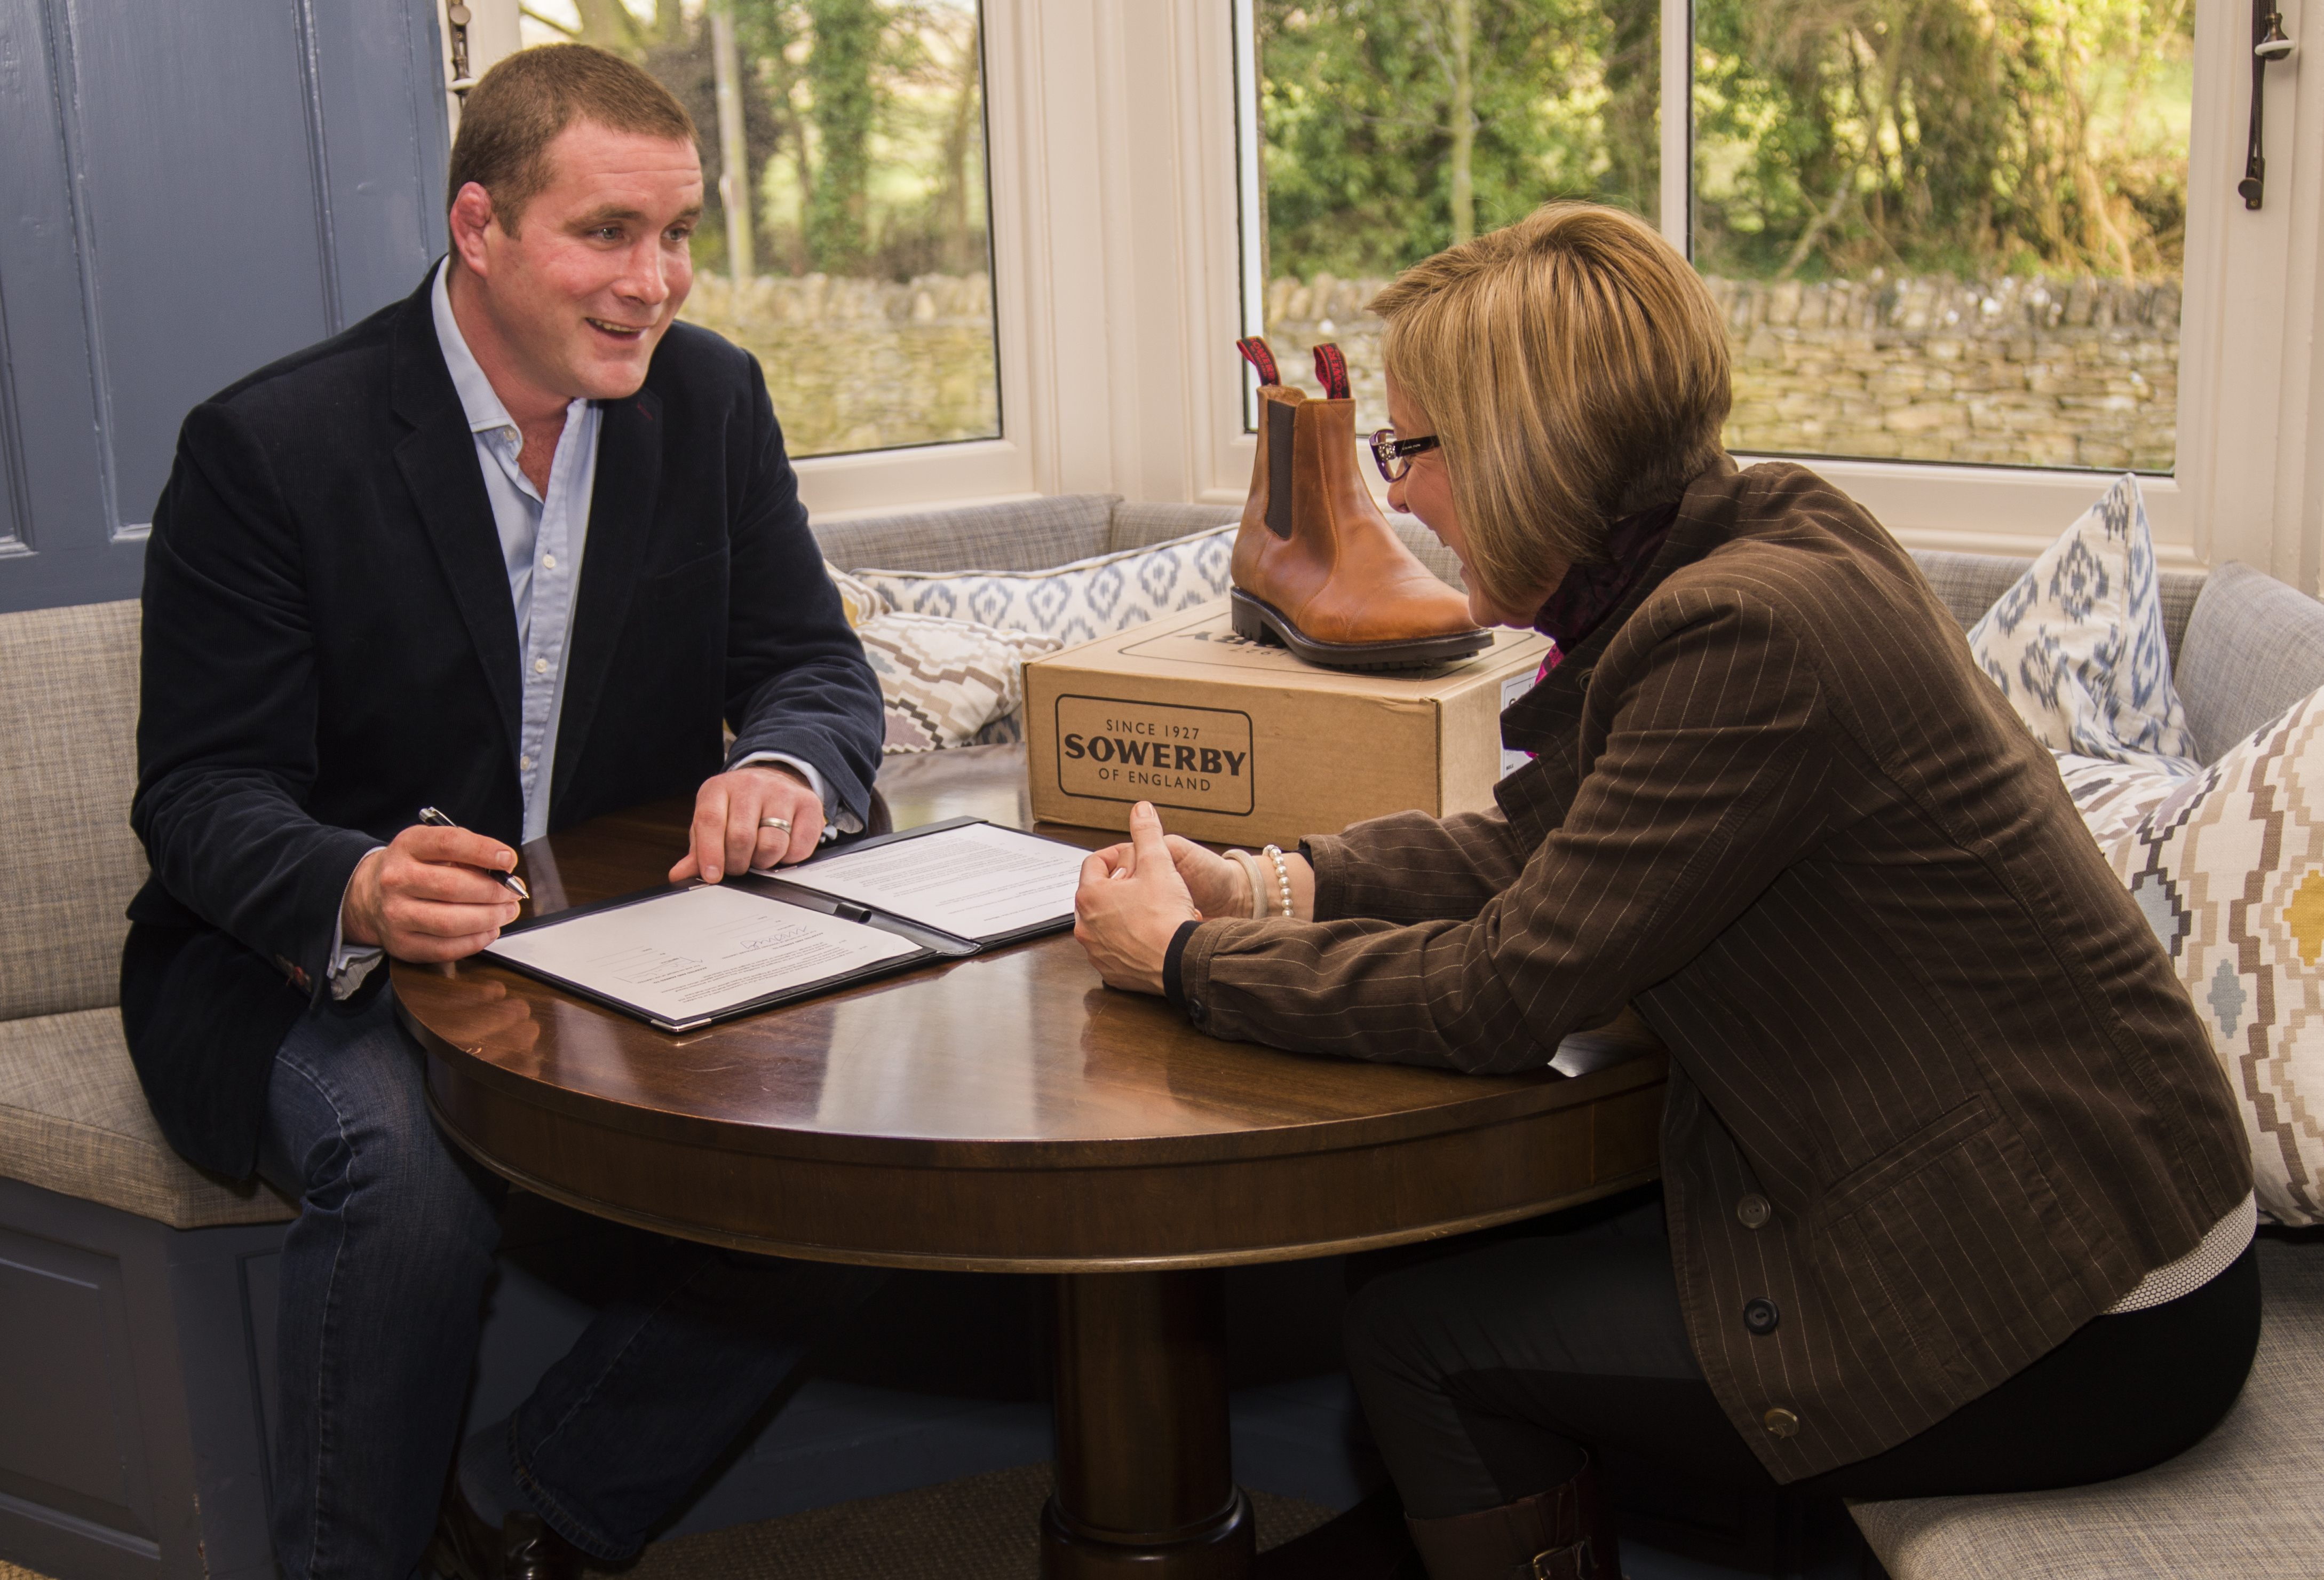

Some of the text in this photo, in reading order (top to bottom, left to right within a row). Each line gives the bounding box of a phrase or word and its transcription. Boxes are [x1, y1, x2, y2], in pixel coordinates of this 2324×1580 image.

[1106, 719, 1200, 740] SINCE 1927
[1064, 733, 1247, 777] SOWERBY
[1099, 768, 1211, 792] OF ENGLAND
